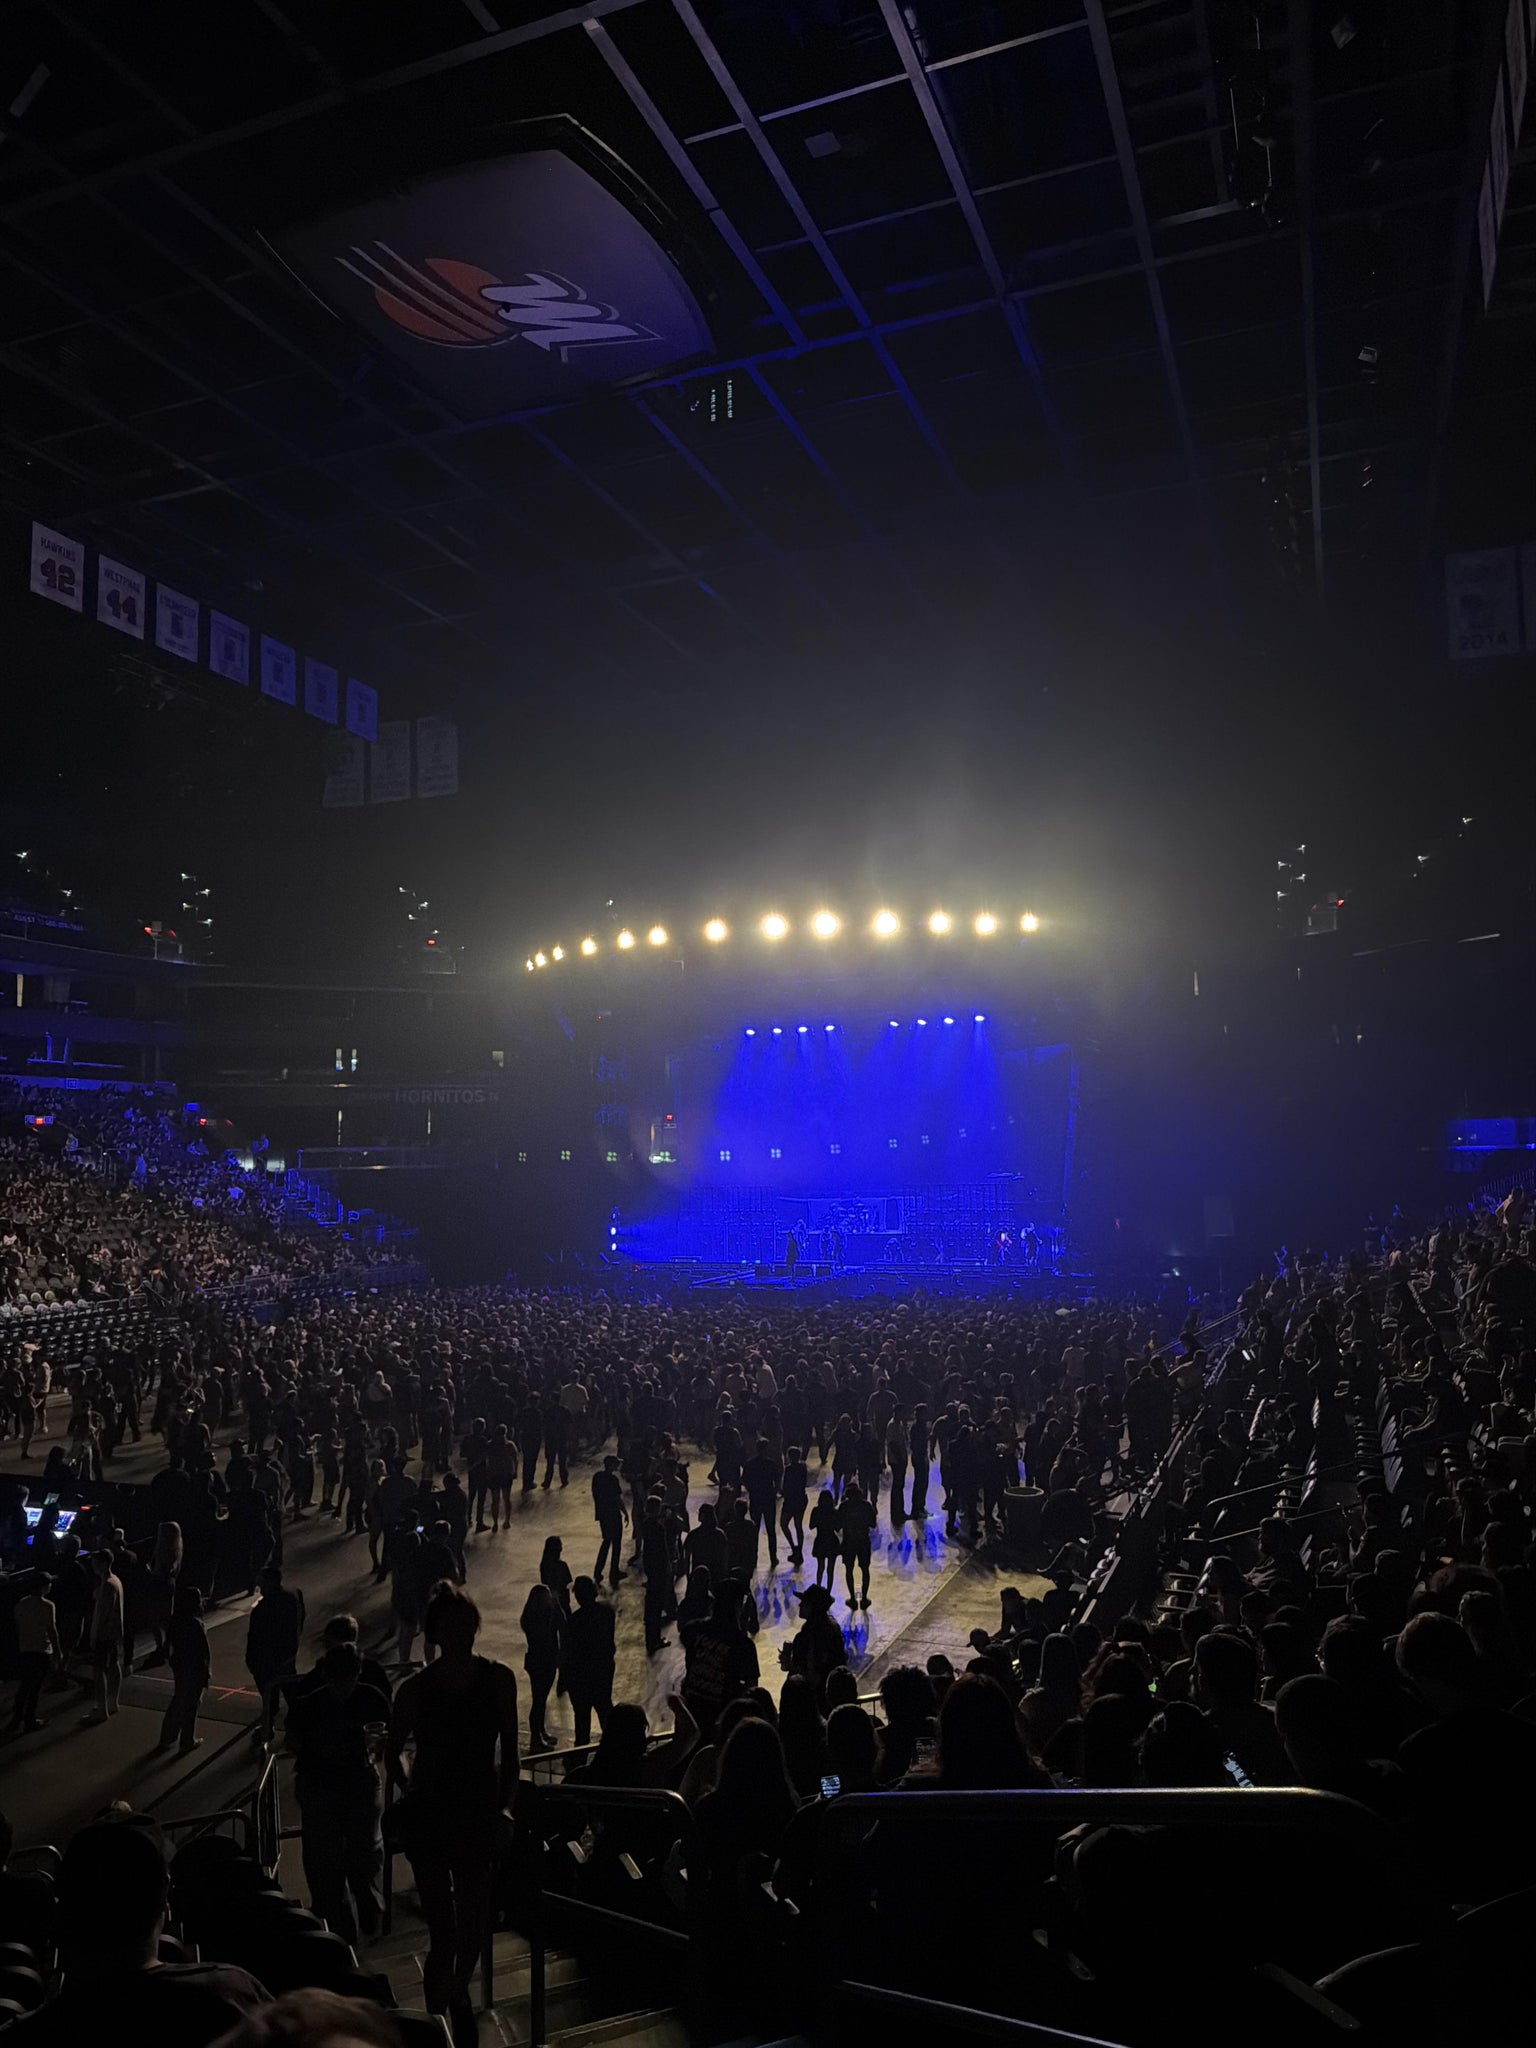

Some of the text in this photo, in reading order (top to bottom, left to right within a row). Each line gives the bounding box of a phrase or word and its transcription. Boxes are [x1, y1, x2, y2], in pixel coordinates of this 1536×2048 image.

[40, 558, 75, 597] 42
[106, 589, 137, 625] 44
[395, 1089, 486, 1104] HORNITOS
